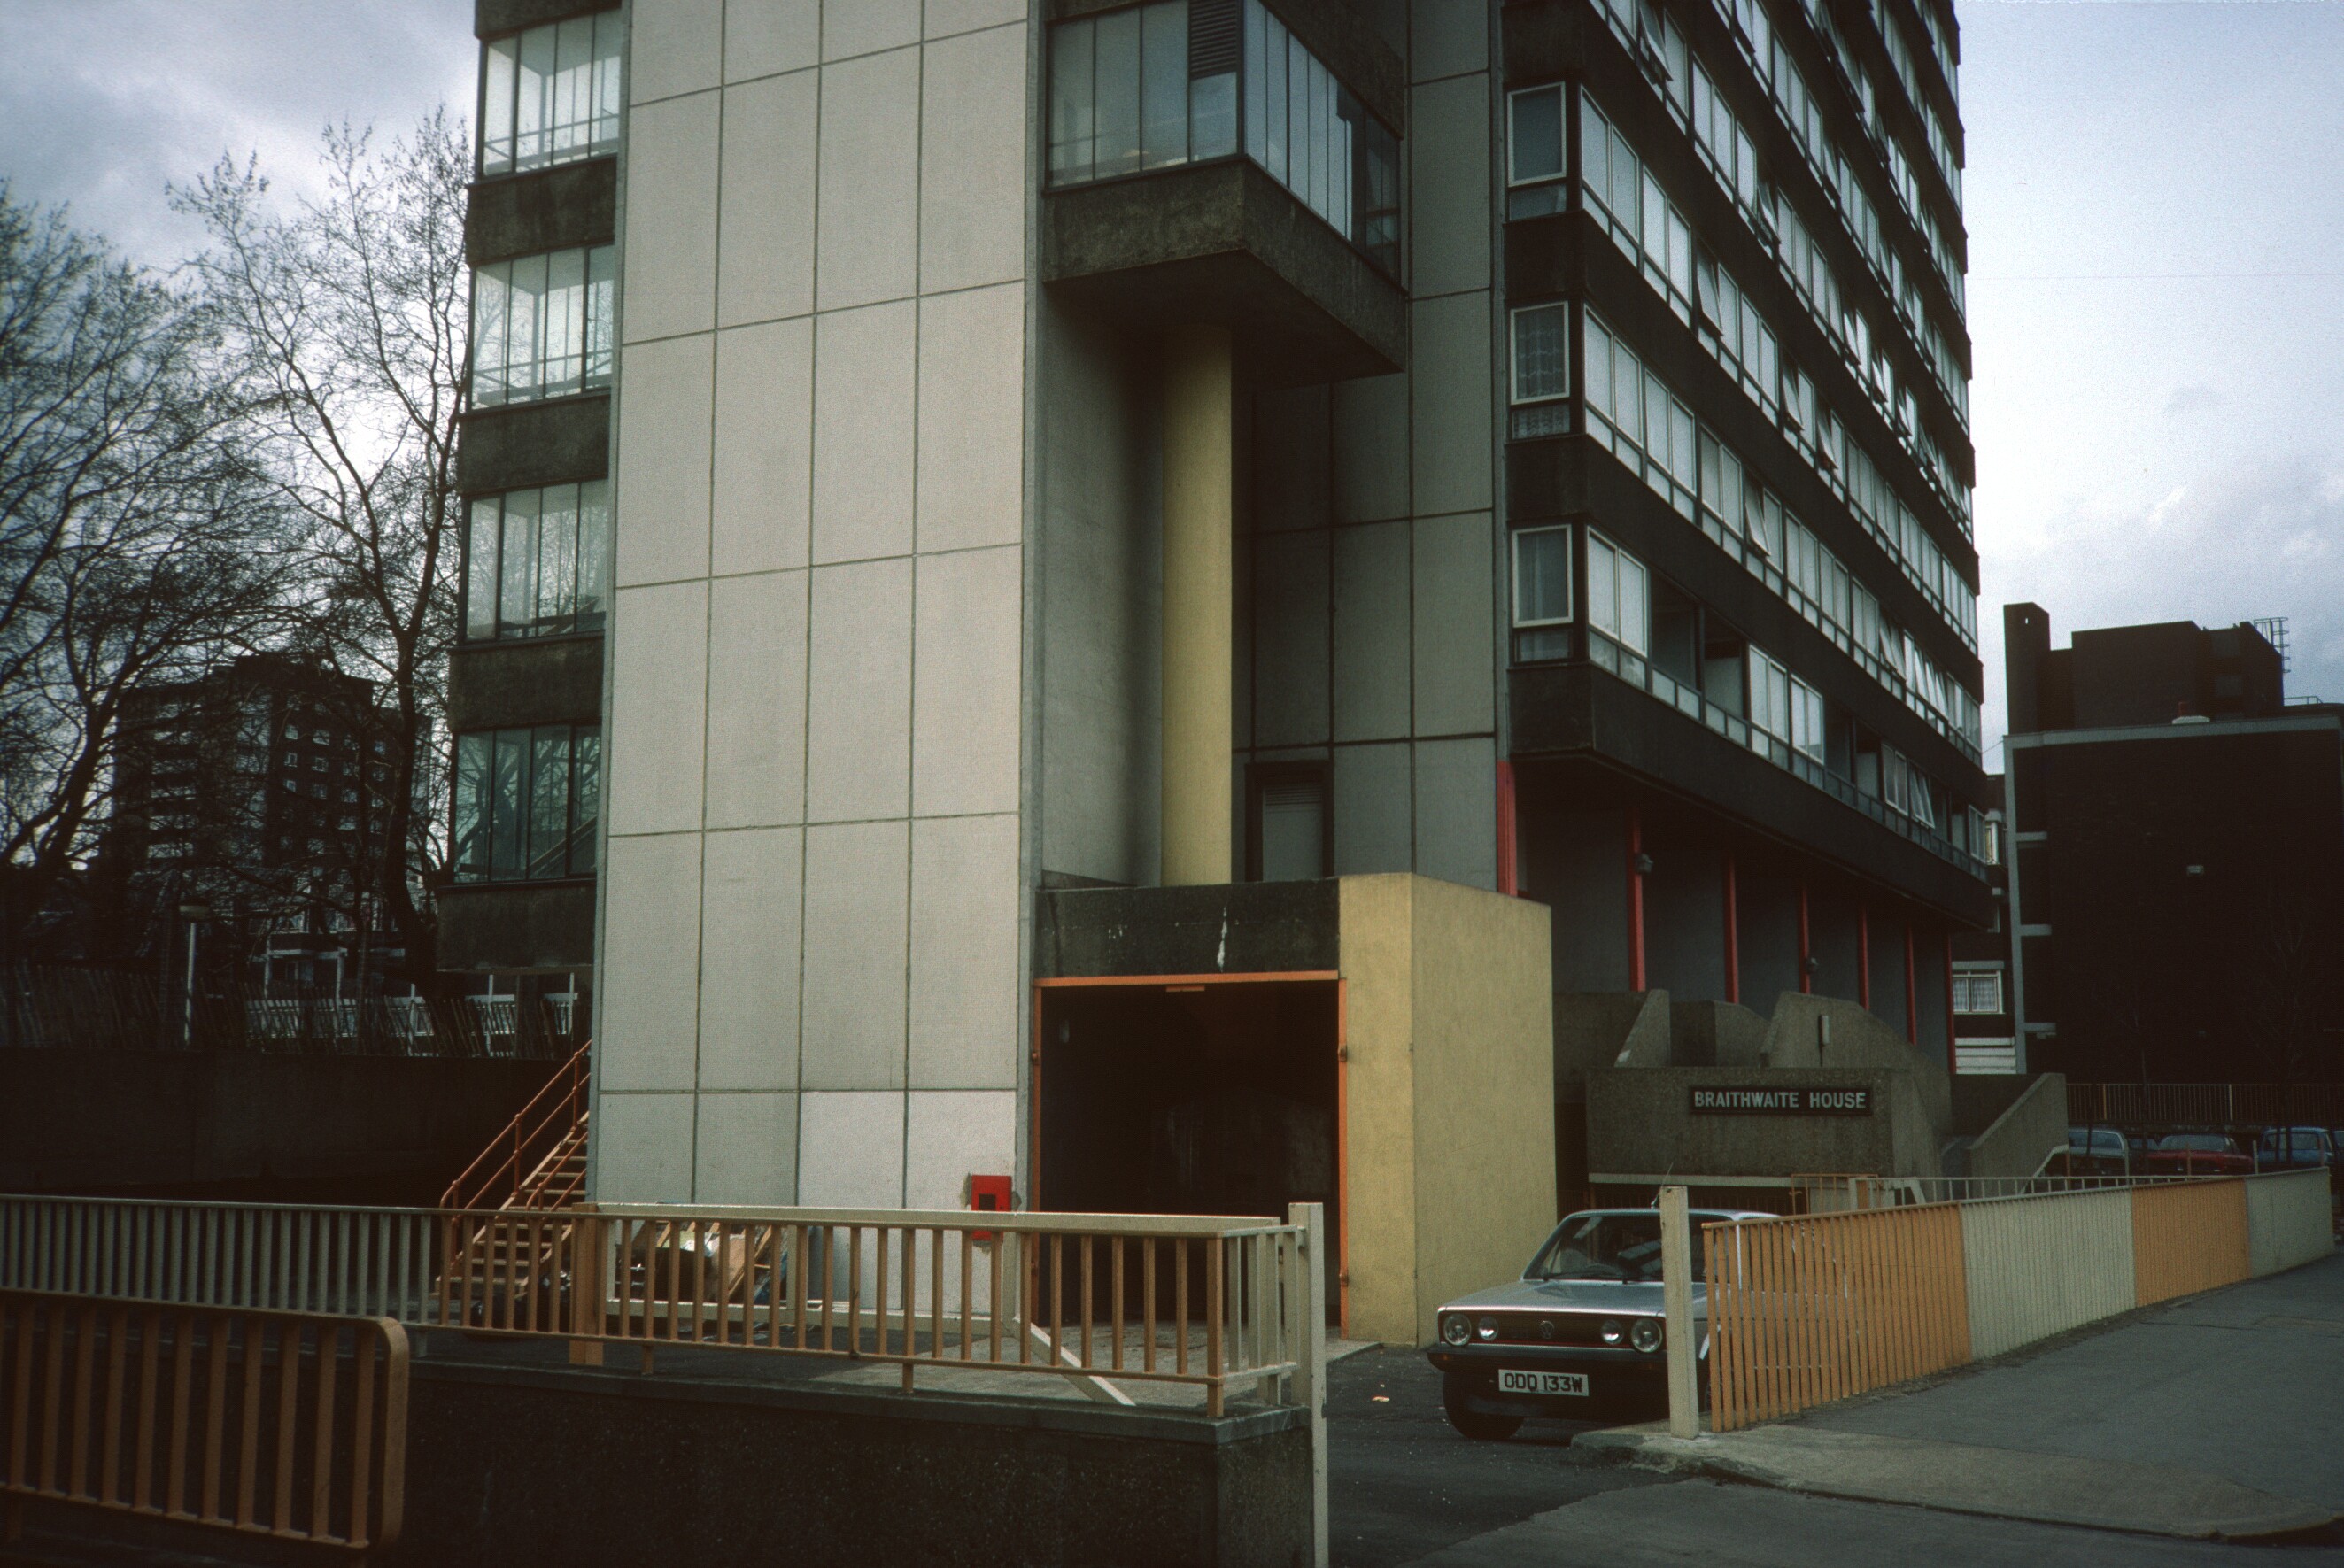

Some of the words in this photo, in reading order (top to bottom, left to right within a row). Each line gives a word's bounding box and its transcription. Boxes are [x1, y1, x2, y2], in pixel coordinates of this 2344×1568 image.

[1694, 1090, 1799, 1108] BRAITHWAITE
[1809, 1091, 1867, 1108] HOUSE
[1543, 1374, 1582, 1393] 133W
